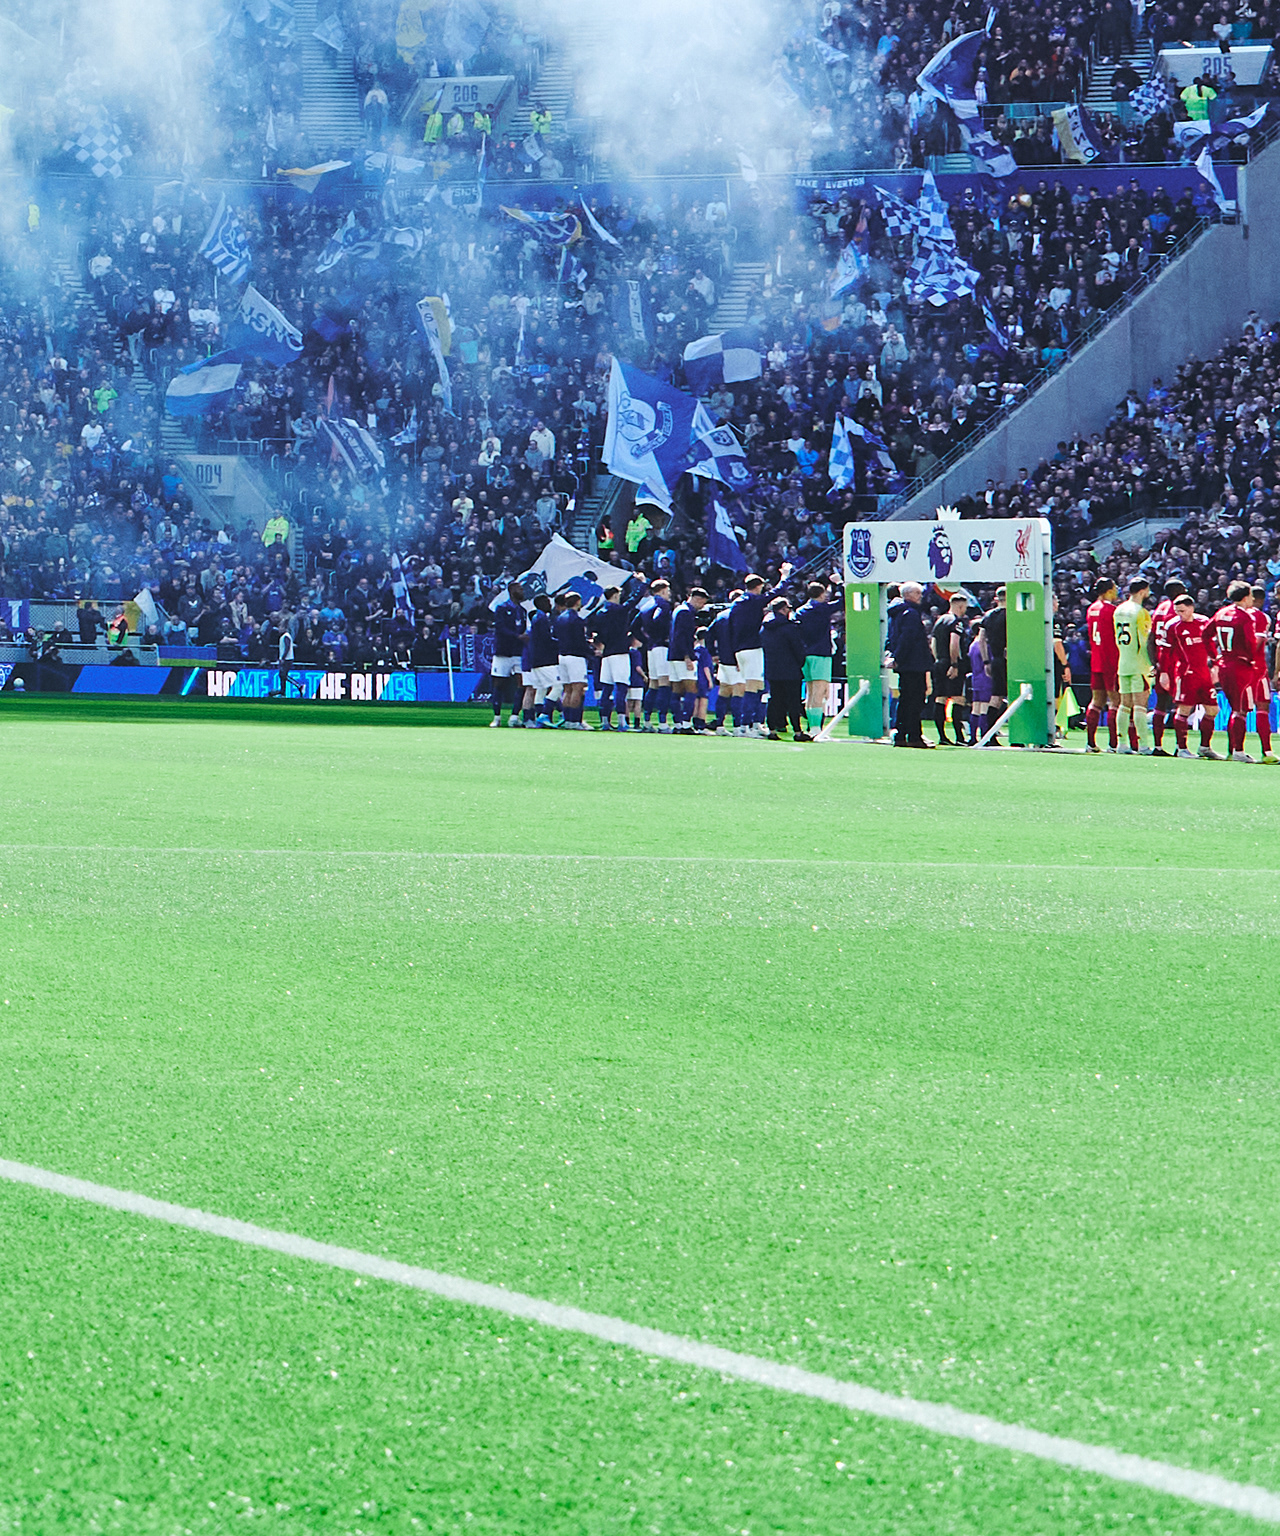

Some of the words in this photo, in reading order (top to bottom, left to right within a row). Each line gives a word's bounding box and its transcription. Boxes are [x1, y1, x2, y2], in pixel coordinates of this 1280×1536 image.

[1203, 56, 1232, 76] 205
[454, 85, 478, 103] 206
[197, 465, 221, 484] 004
[1092, 621, 1101, 645] 4
[1116, 622, 1132, 645] 25
[1216, 626, 1235, 652] 17
